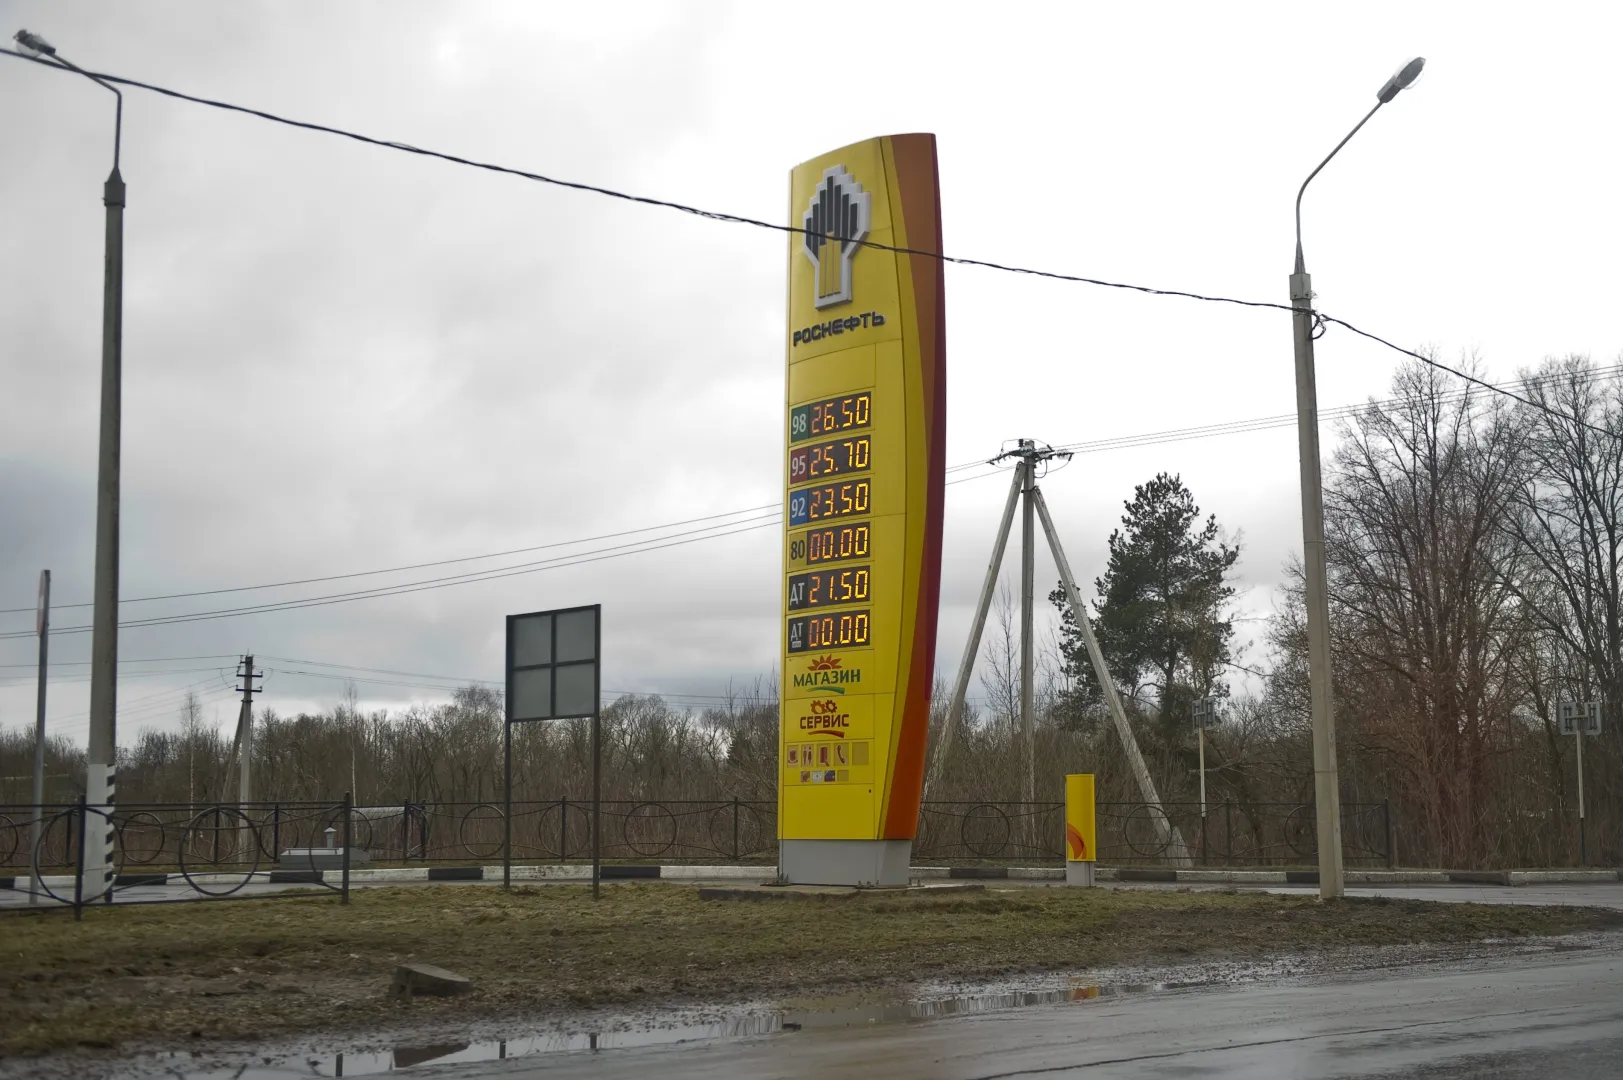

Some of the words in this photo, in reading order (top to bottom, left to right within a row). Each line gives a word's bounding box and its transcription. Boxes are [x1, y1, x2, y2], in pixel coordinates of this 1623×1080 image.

[793, 311, 885, 347] РОСНЕФТЬ
[792, 413, 807, 434] 98
[812, 396, 869, 433] 26.50
[791, 455, 806, 477] 95
[810, 439, 869, 475] 25.70
[791, 497, 806, 518] 92
[810, 483, 868, 518] 23.50
[791, 540, 805, 560] 80
[810, 526, 868, 561] 00.00
[809, 570, 868, 603] 21.50
[809, 614, 868, 647] 00.00
[793, 668, 861, 687] МАГАЗИН
[799, 714, 850, 729] СЕРВИС
